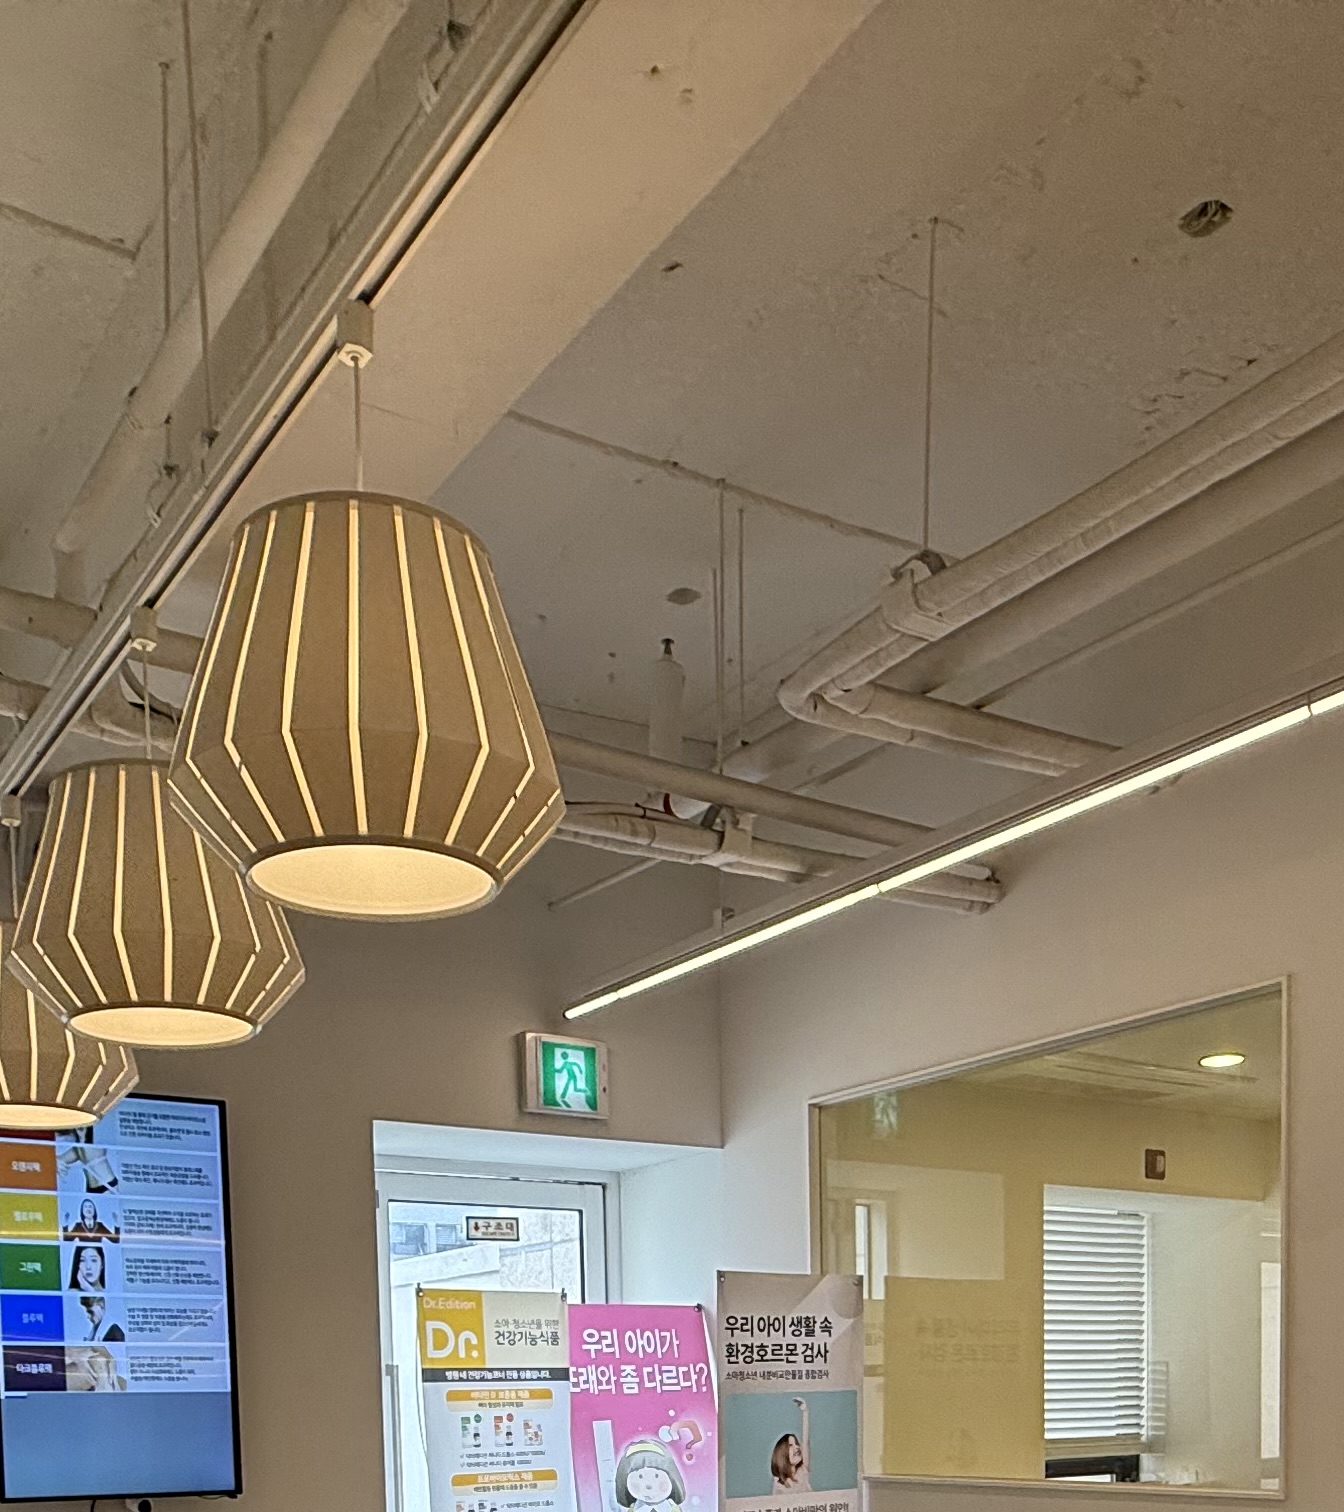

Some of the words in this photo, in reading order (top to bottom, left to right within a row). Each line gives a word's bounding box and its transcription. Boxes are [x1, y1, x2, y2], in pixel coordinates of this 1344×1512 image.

[423, 1298, 477, 1310] Dr.Edition
[725, 1315, 754, 1338] 우리
[757, 1315, 786, 1338] 아이
[789, 1316, 817, 1338] 생활
[819, 1316, 833, 1338] 속
[425, 1320, 479, 1359] Dr.
[494, 1330, 560, 1346] 건강기능식품
[582, 1329, 620, 1359] 우리
[625, 1328, 680, 1358] 아이가
[725, 1342, 799, 1364] 환경호르몬
[801, 1342, 829, 1364] 검사
[620, 1364, 640, 1394] 좀
[643, 1363, 708, 1394] 다르다?
[725, 1370, 758, 1381] 소아청소년
